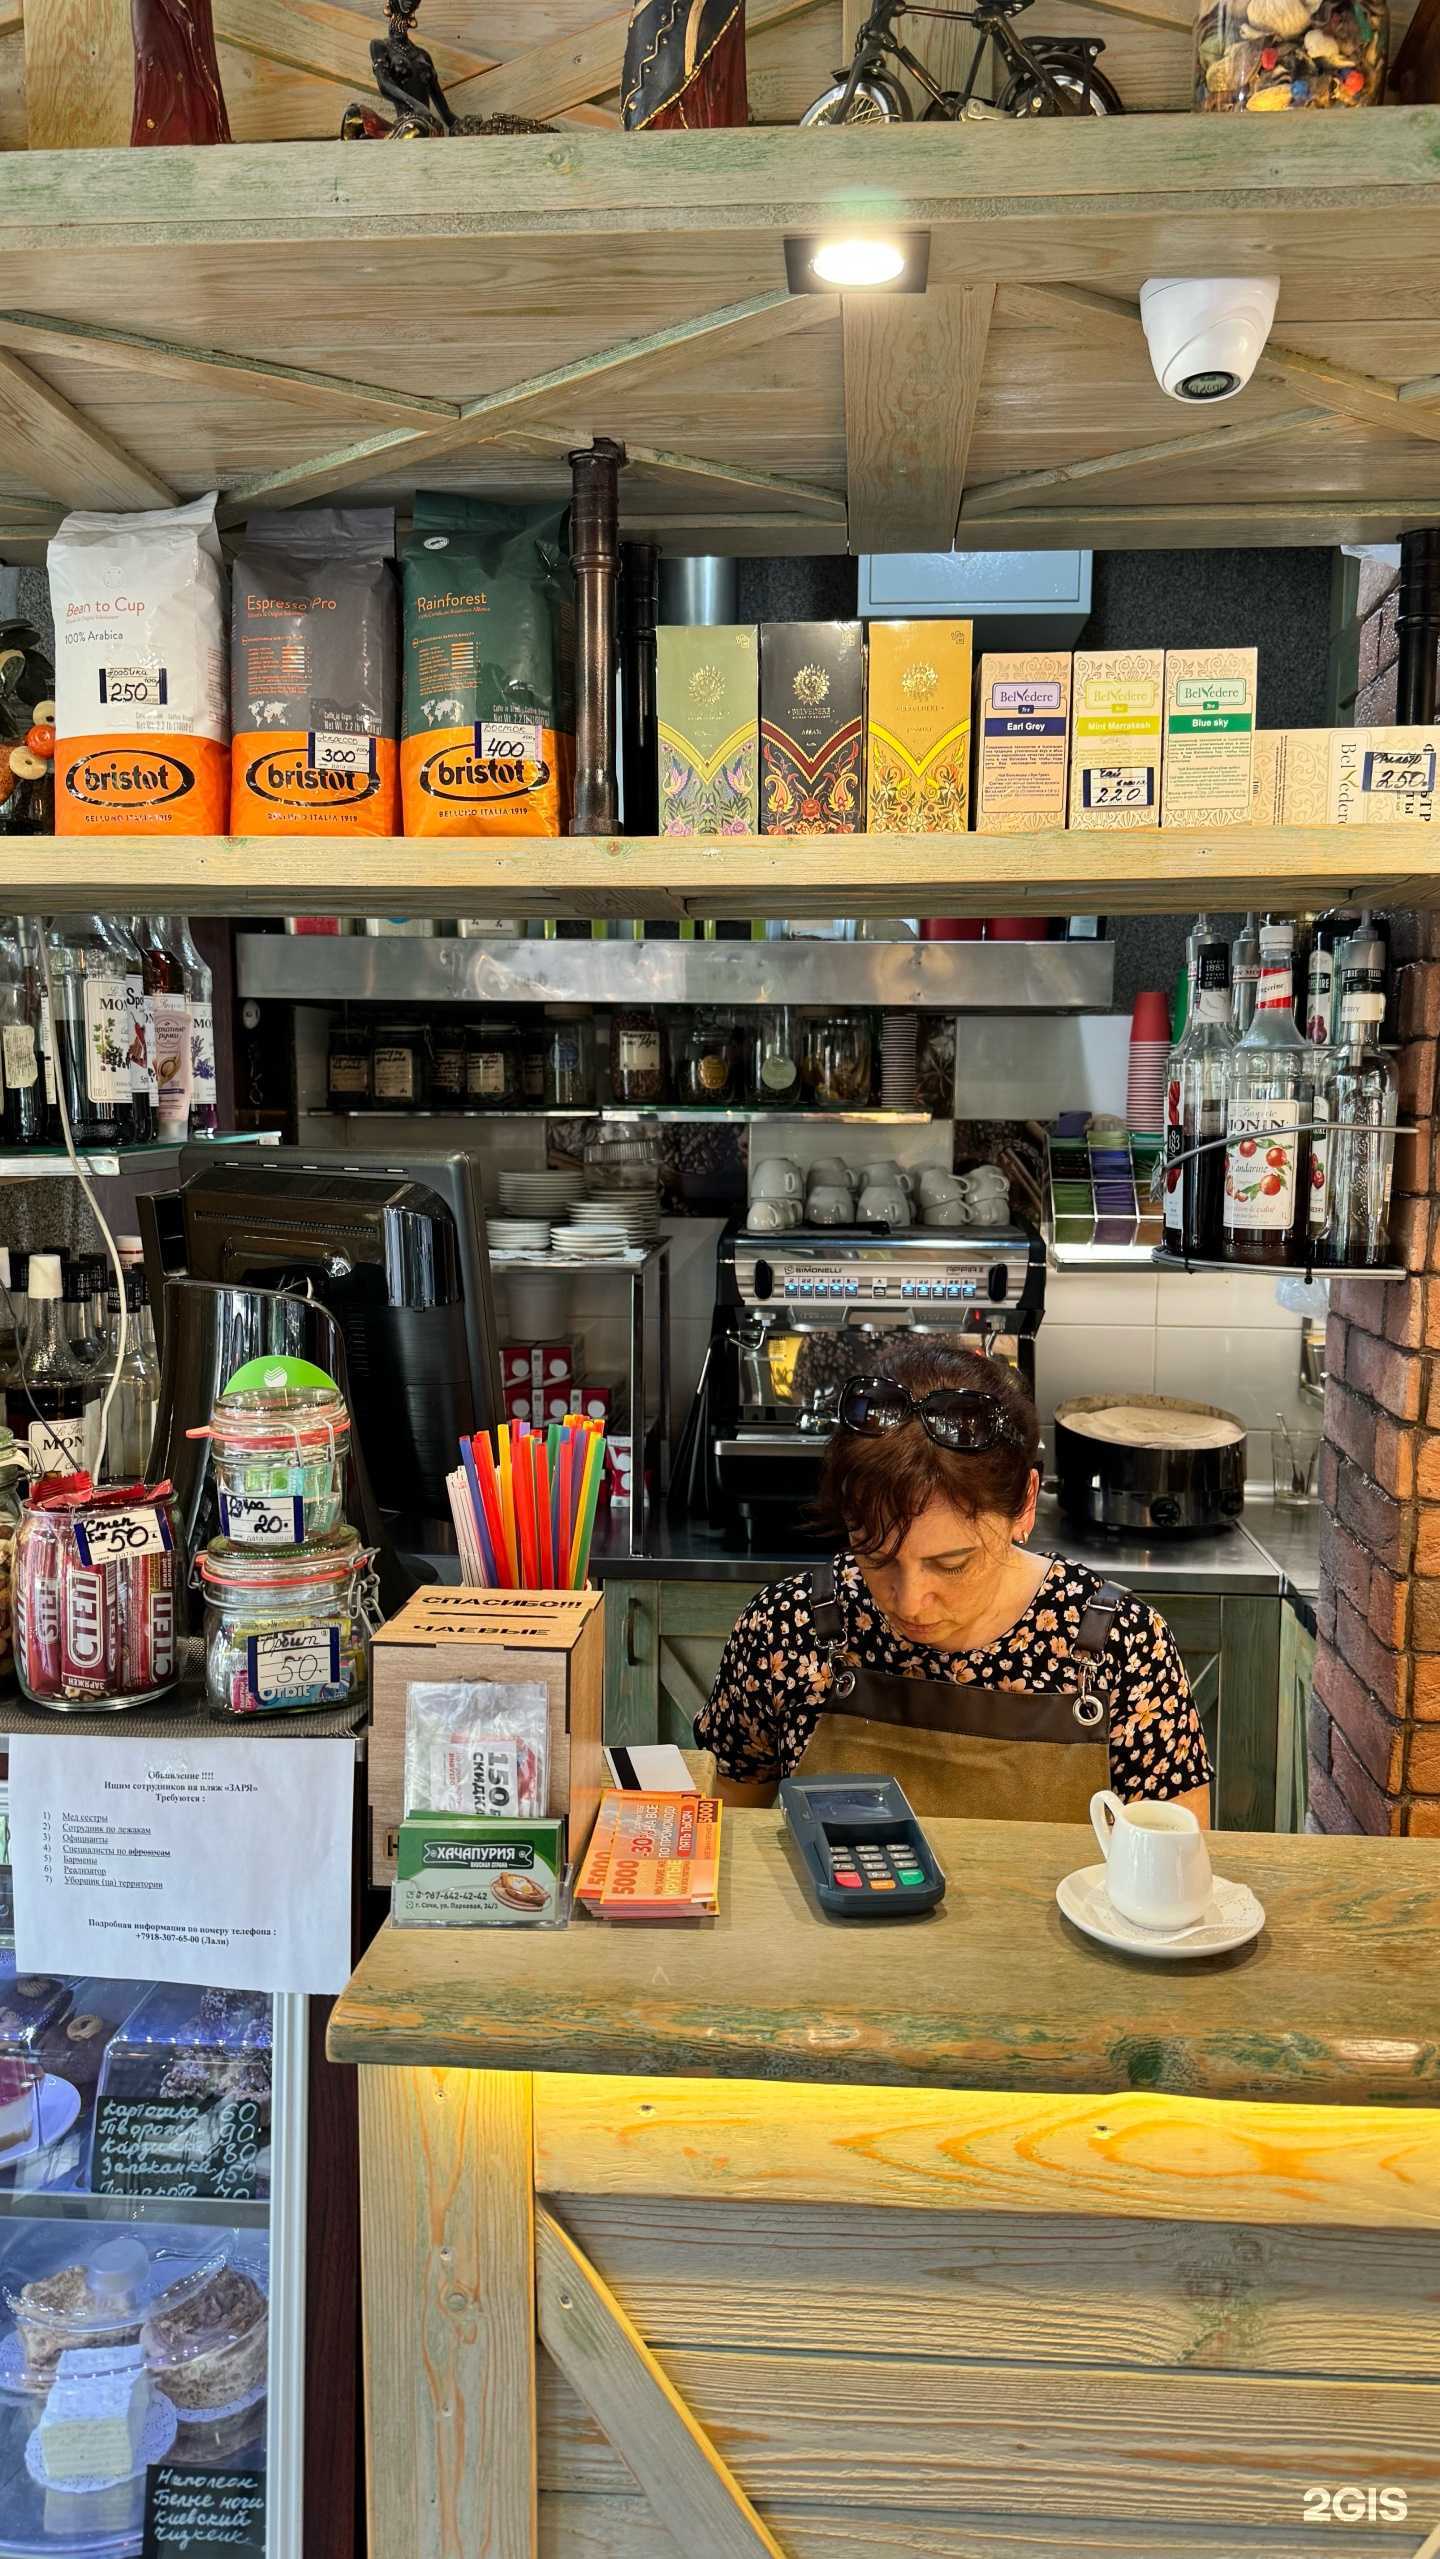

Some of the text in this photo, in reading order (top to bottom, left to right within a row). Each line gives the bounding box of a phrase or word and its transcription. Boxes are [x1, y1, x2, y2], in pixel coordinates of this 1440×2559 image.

[66, 597, 145, 617] Bean to Cup
[312, 597, 337, 610] Pro
[417, 592, 488, 613] Rainforest
[65, 630, 124, 645] 100% Arabica
[111, 683, 147, 702] 250
[1000, 688, 1053, 703] BelVedere
[1185, 684, 1239, 699] BelVedere
[1006, 722, 1045, 733] Earl Grey
[1088, 722, 1106, 731] Mint
[1192, 718, 1229, 729] Blue sky
[488, 737, 525, 757] 400
[322, 749, 355, 762] 300
[85, 763, 169, 791] bristot
[268, 762, 355, 789] bristot
[439, 757, 524, 785] bristot
[1096, 788, 1141, 804] 220
[1206, 964, 1225, 972] 1883
[422, 1596, 583, 1609] СПАСИБО!!!
[72, 1577, 97, 1662] СТЕП
[413, 1625, 551, 1635] ЧАЕВЫЕ
[153, 1597, 172, 1680] СТЕП
[487, 1752, 510, 1807] 150
[133, 1783, 186, 1794] сотрудников
[200, 1784, 222, 1792] пляж
[224, 1783, 258, 1793] «ЗАРЯ»
[155, 1793, 200, 1804] Требуются
[697, 1802, 714, 1823] 5000
[62, 1823, 103, 1834] Сотрудник
[437, 1846, 515, 1861] ХАЧАПУРИЯ
[659, 1844, 671, 1858] ПО
[119, 1880, 163, 1890] территории
[612, 1860, 640, 1895] 5000
[134, 1922, 186, 1933] информация
[200, 1926, 229, 1936] номеру
[231, 1926, 271, 1937] телефона
[135, 1932, 200, 1944] +7918-307-65-00
[220, 2102, 257, 2123] 60
[219, 2123, 256, 2145] 90
[223, 2142, 258, 2163] 80
[210, 2163, 256, 2184] 150
[158, 2469, 258, 2488] Наполеон
[153, 2489, 264, 2509] Белые ночи
